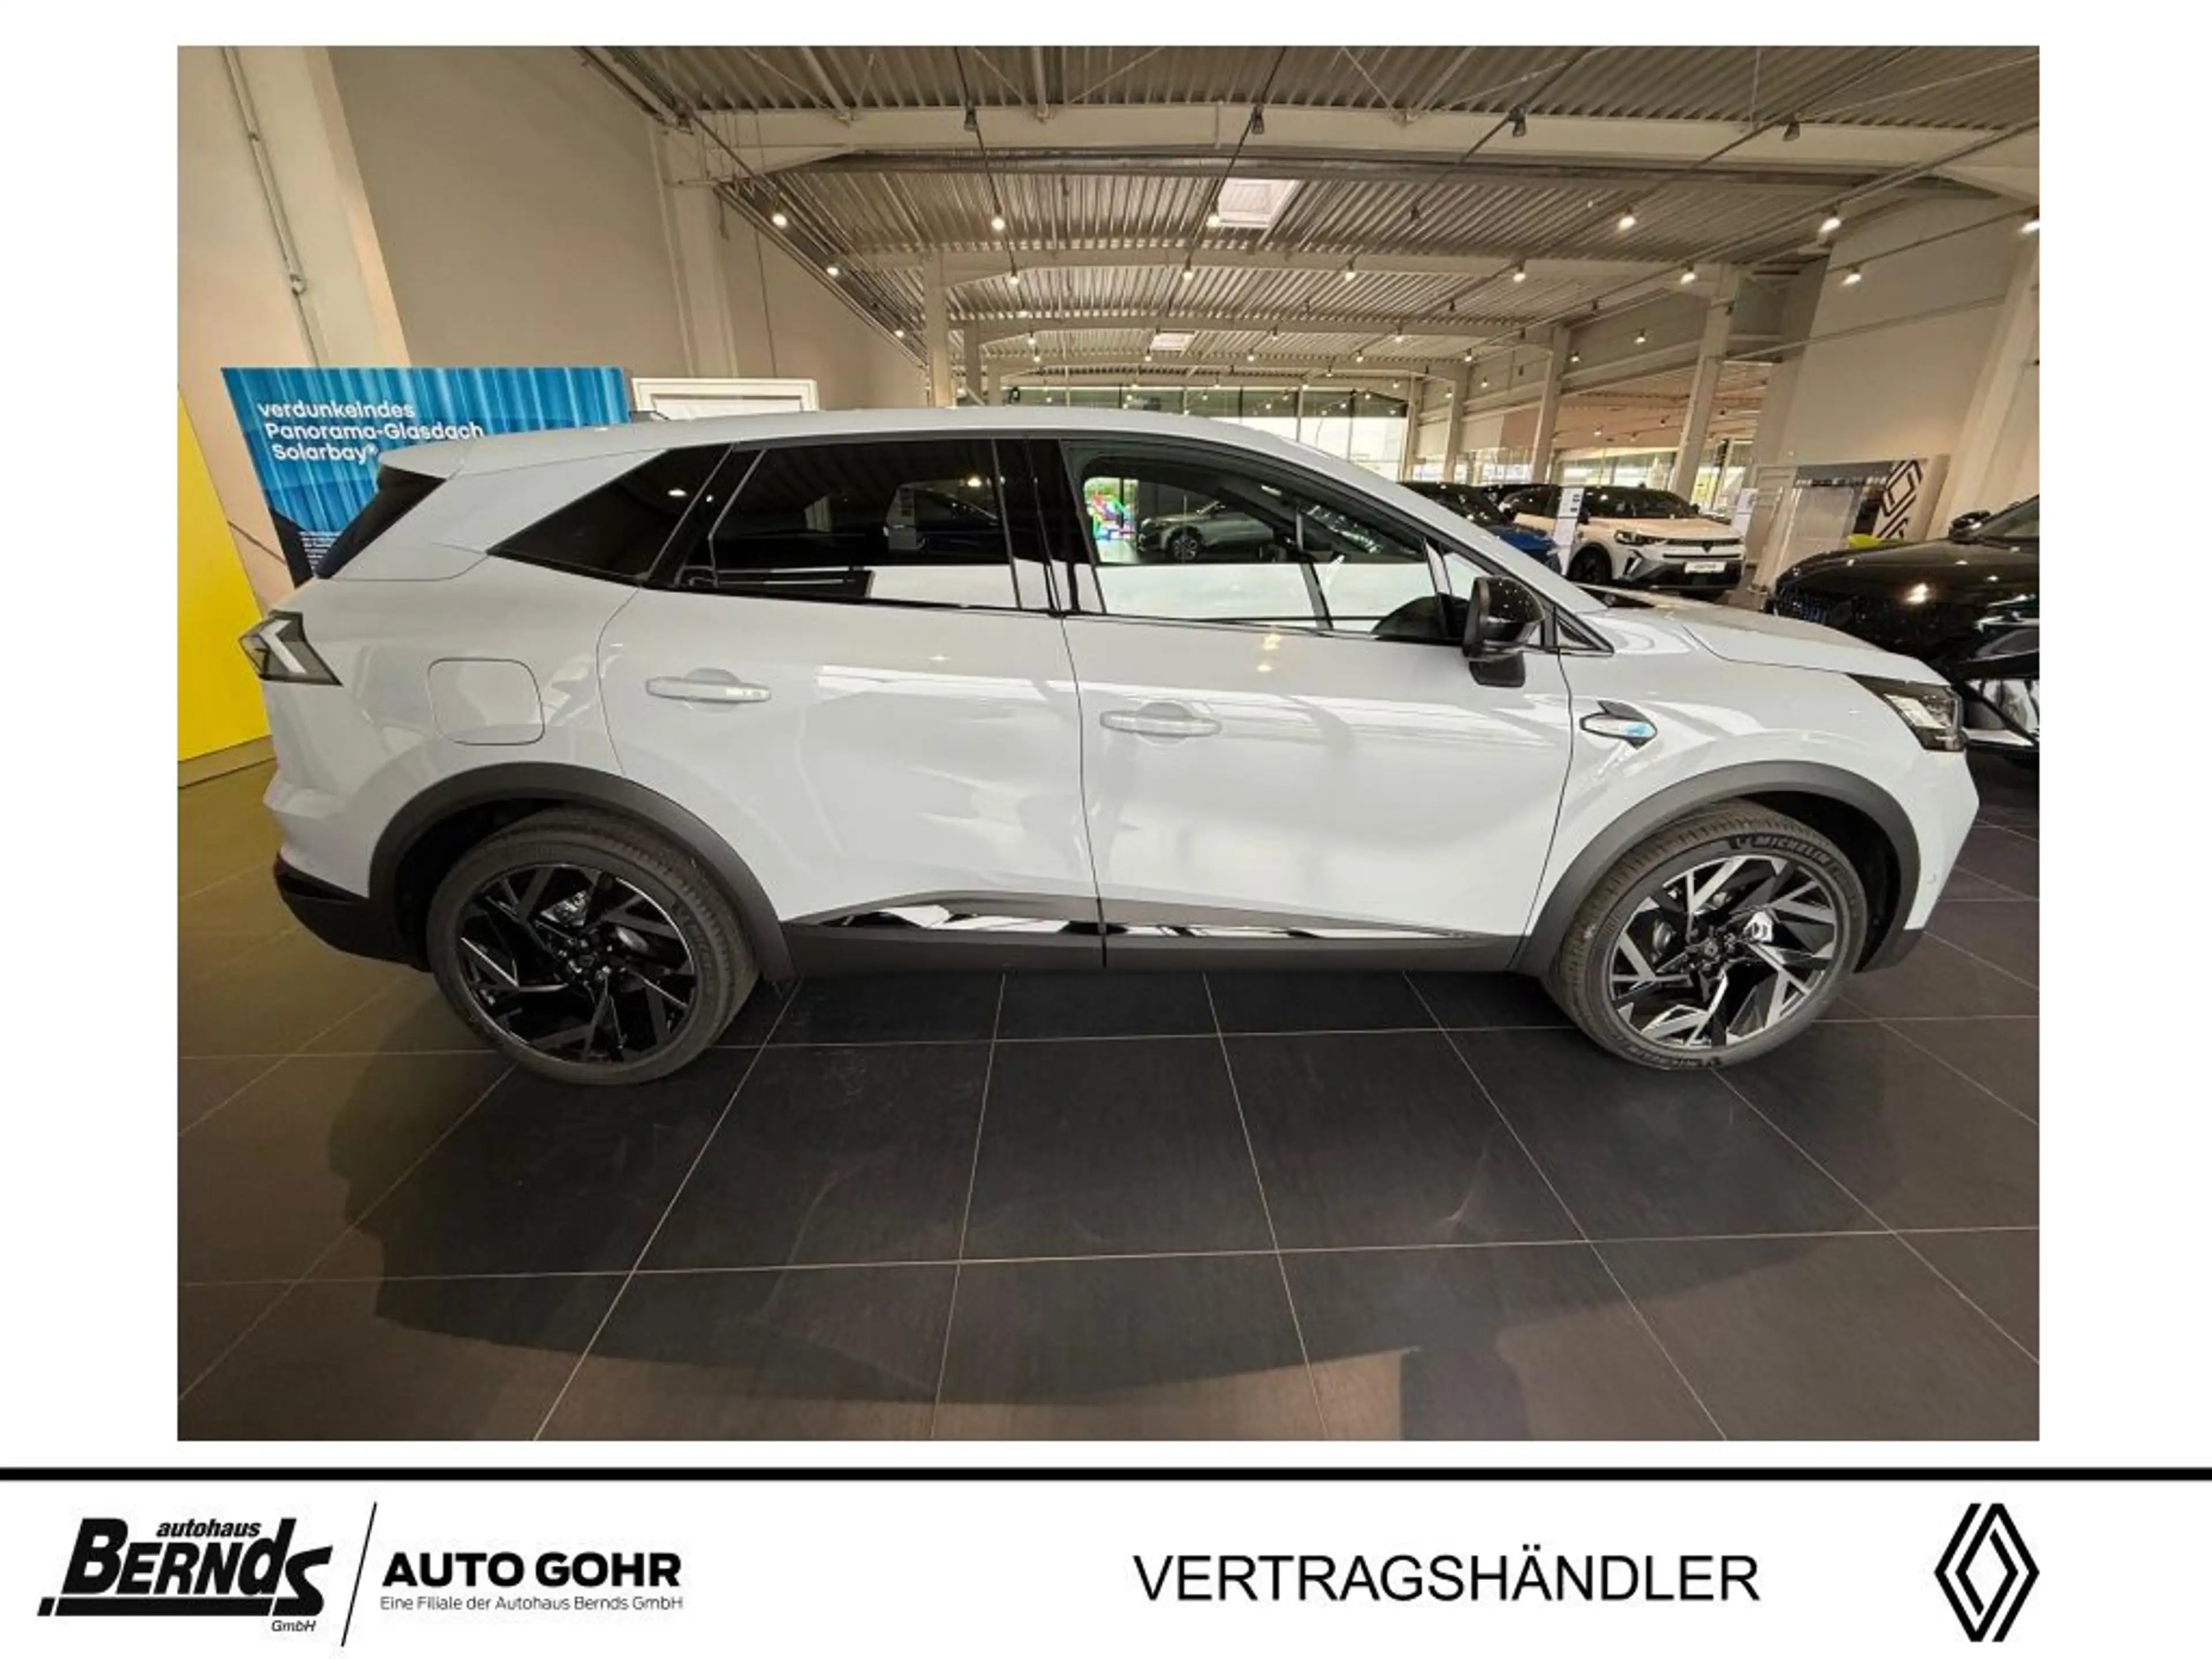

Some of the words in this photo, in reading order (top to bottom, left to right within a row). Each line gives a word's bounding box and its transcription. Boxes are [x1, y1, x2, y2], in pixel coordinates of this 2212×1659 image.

[257, 400, 415, 418] verdunkelndes
[265, 421, 484, 440] Panorama-Glasdach
[1752, 836, 1834, 866] MICHELIN
